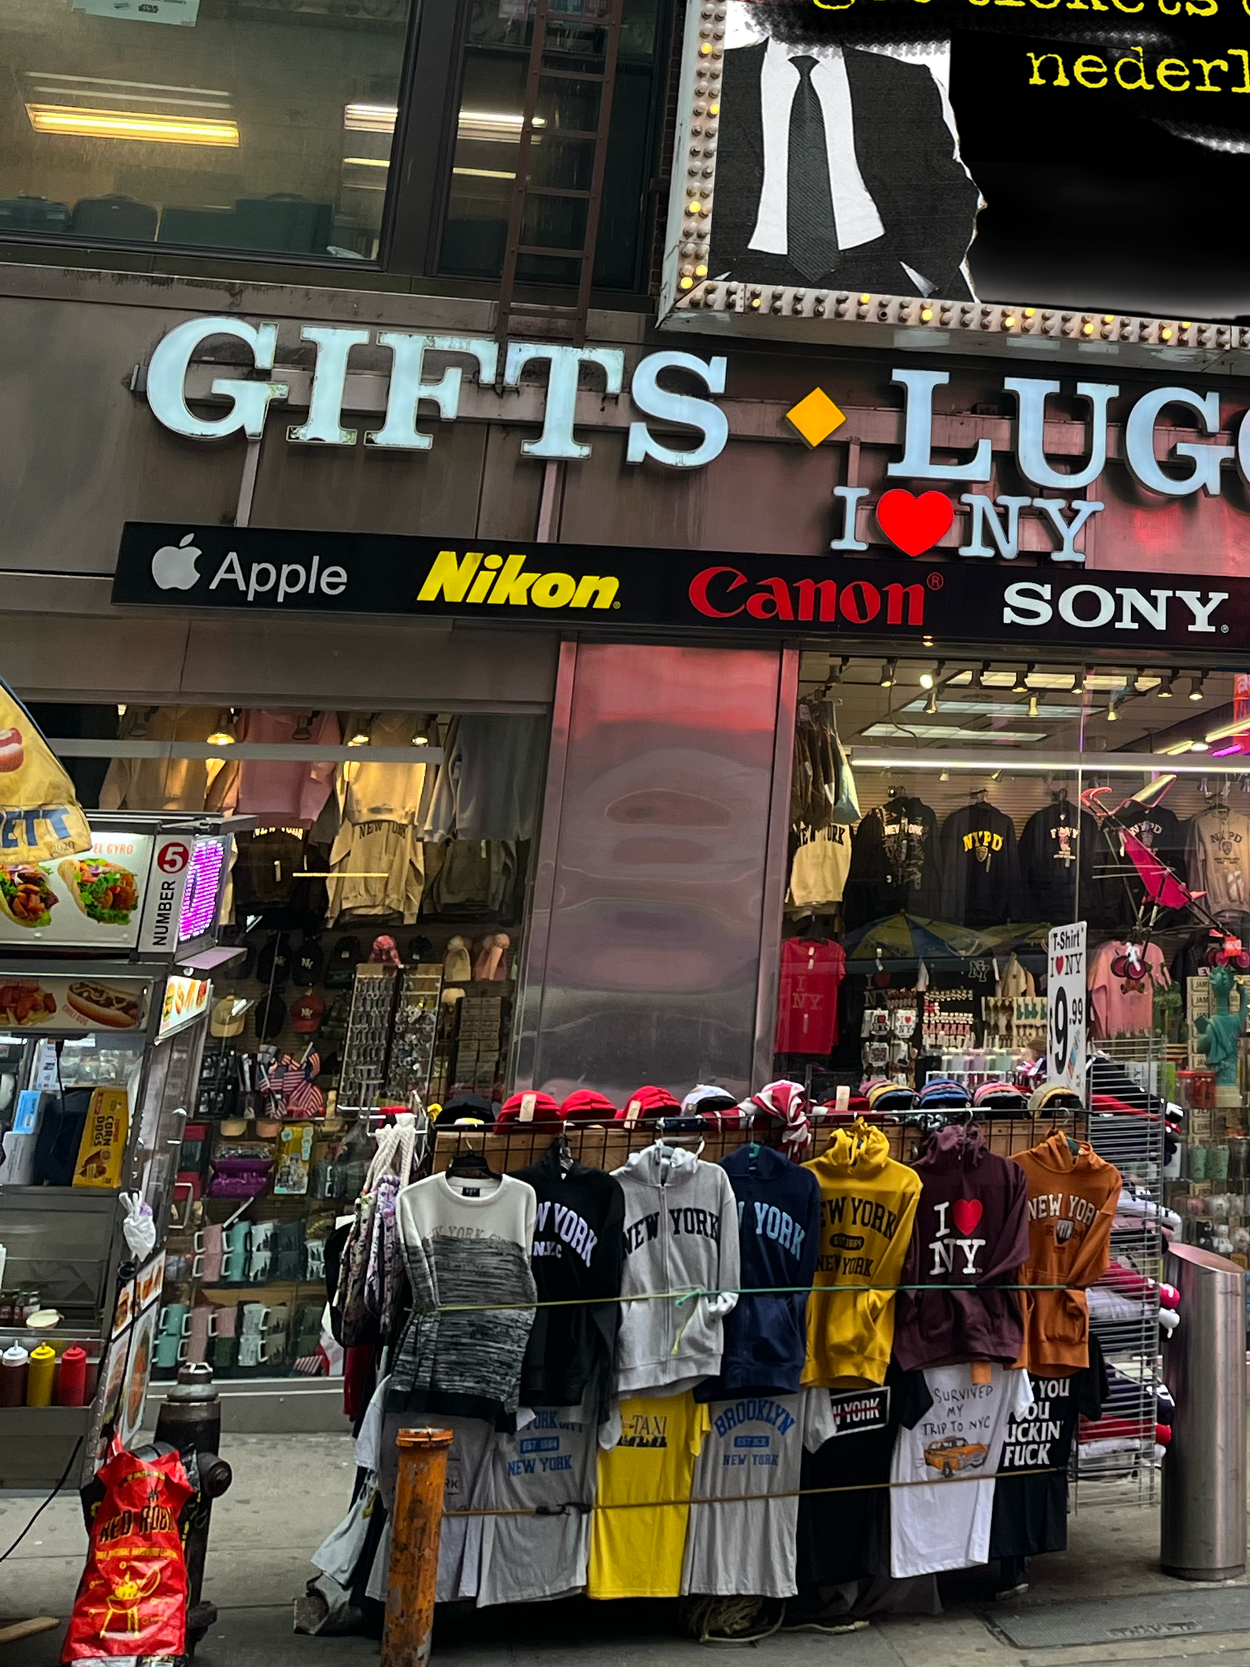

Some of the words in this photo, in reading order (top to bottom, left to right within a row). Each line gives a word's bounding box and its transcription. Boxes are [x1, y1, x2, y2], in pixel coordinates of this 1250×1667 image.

[145, 315, 728, 468] GIFTS
[831, 486, 870, 552] I
[958, 493, 1104, 562] NY
[209, 551, 347, 603] Apple
[417, 551, 621, 610] Nikon
[1003, 582, 1228, 633] SONY
[0, 808, 70, 849] ETT
[360, 822, 382, 840] NEW
[962, 831, 1003, 852] NYPD
[107, 843, 133, 855] GYRO
[163, 846, 184, 874] 5
[152, 880, 176, 946] NUMBER
[1064, 953, 1083, 975] NY
[94, 1116, 105, 1147] DOGS
[103, 1115, 115, 1146] CORN
[851, 1196, 898, 1242] YORK
[933, 1201, 950, 1238] I
[1028, 1193, 1063, 1221] NEW
[1068, 1195, 1101, 1227] YOR
[553, 1203, 599, 1268] YORK
[669, 1207, 720, 1243] YORK
[754, 1201, 807, 1261] YORK
[842, 1257, 874, 1277] YORK
[928, 1238, 986, 1275] NY
[935, 1385, 994, 1404] SURVIVED
[1039, 1379, 1070, 1399] YOU
[633, 1415, 668, 1435] TAXI
[713, 1398, 795, 1439] BROOKLYN
[947, 1404, 964, 1418] MY
[1026, 1402, 1050, 1421] OU
[922, 1422, 947, 1436] TRIP
[951, 1421, 963, 1433] TO
[969, 1416, 991, 1432] NYC
[507, 1459, 536, 1477] NEW
[539, 1454, 573, 1473] YORK
[722, 1454, 747, 1466] NEW
[752, 1454, 779, 1466] YORK
[1003, 1443, 1052, 1467] FUCK
